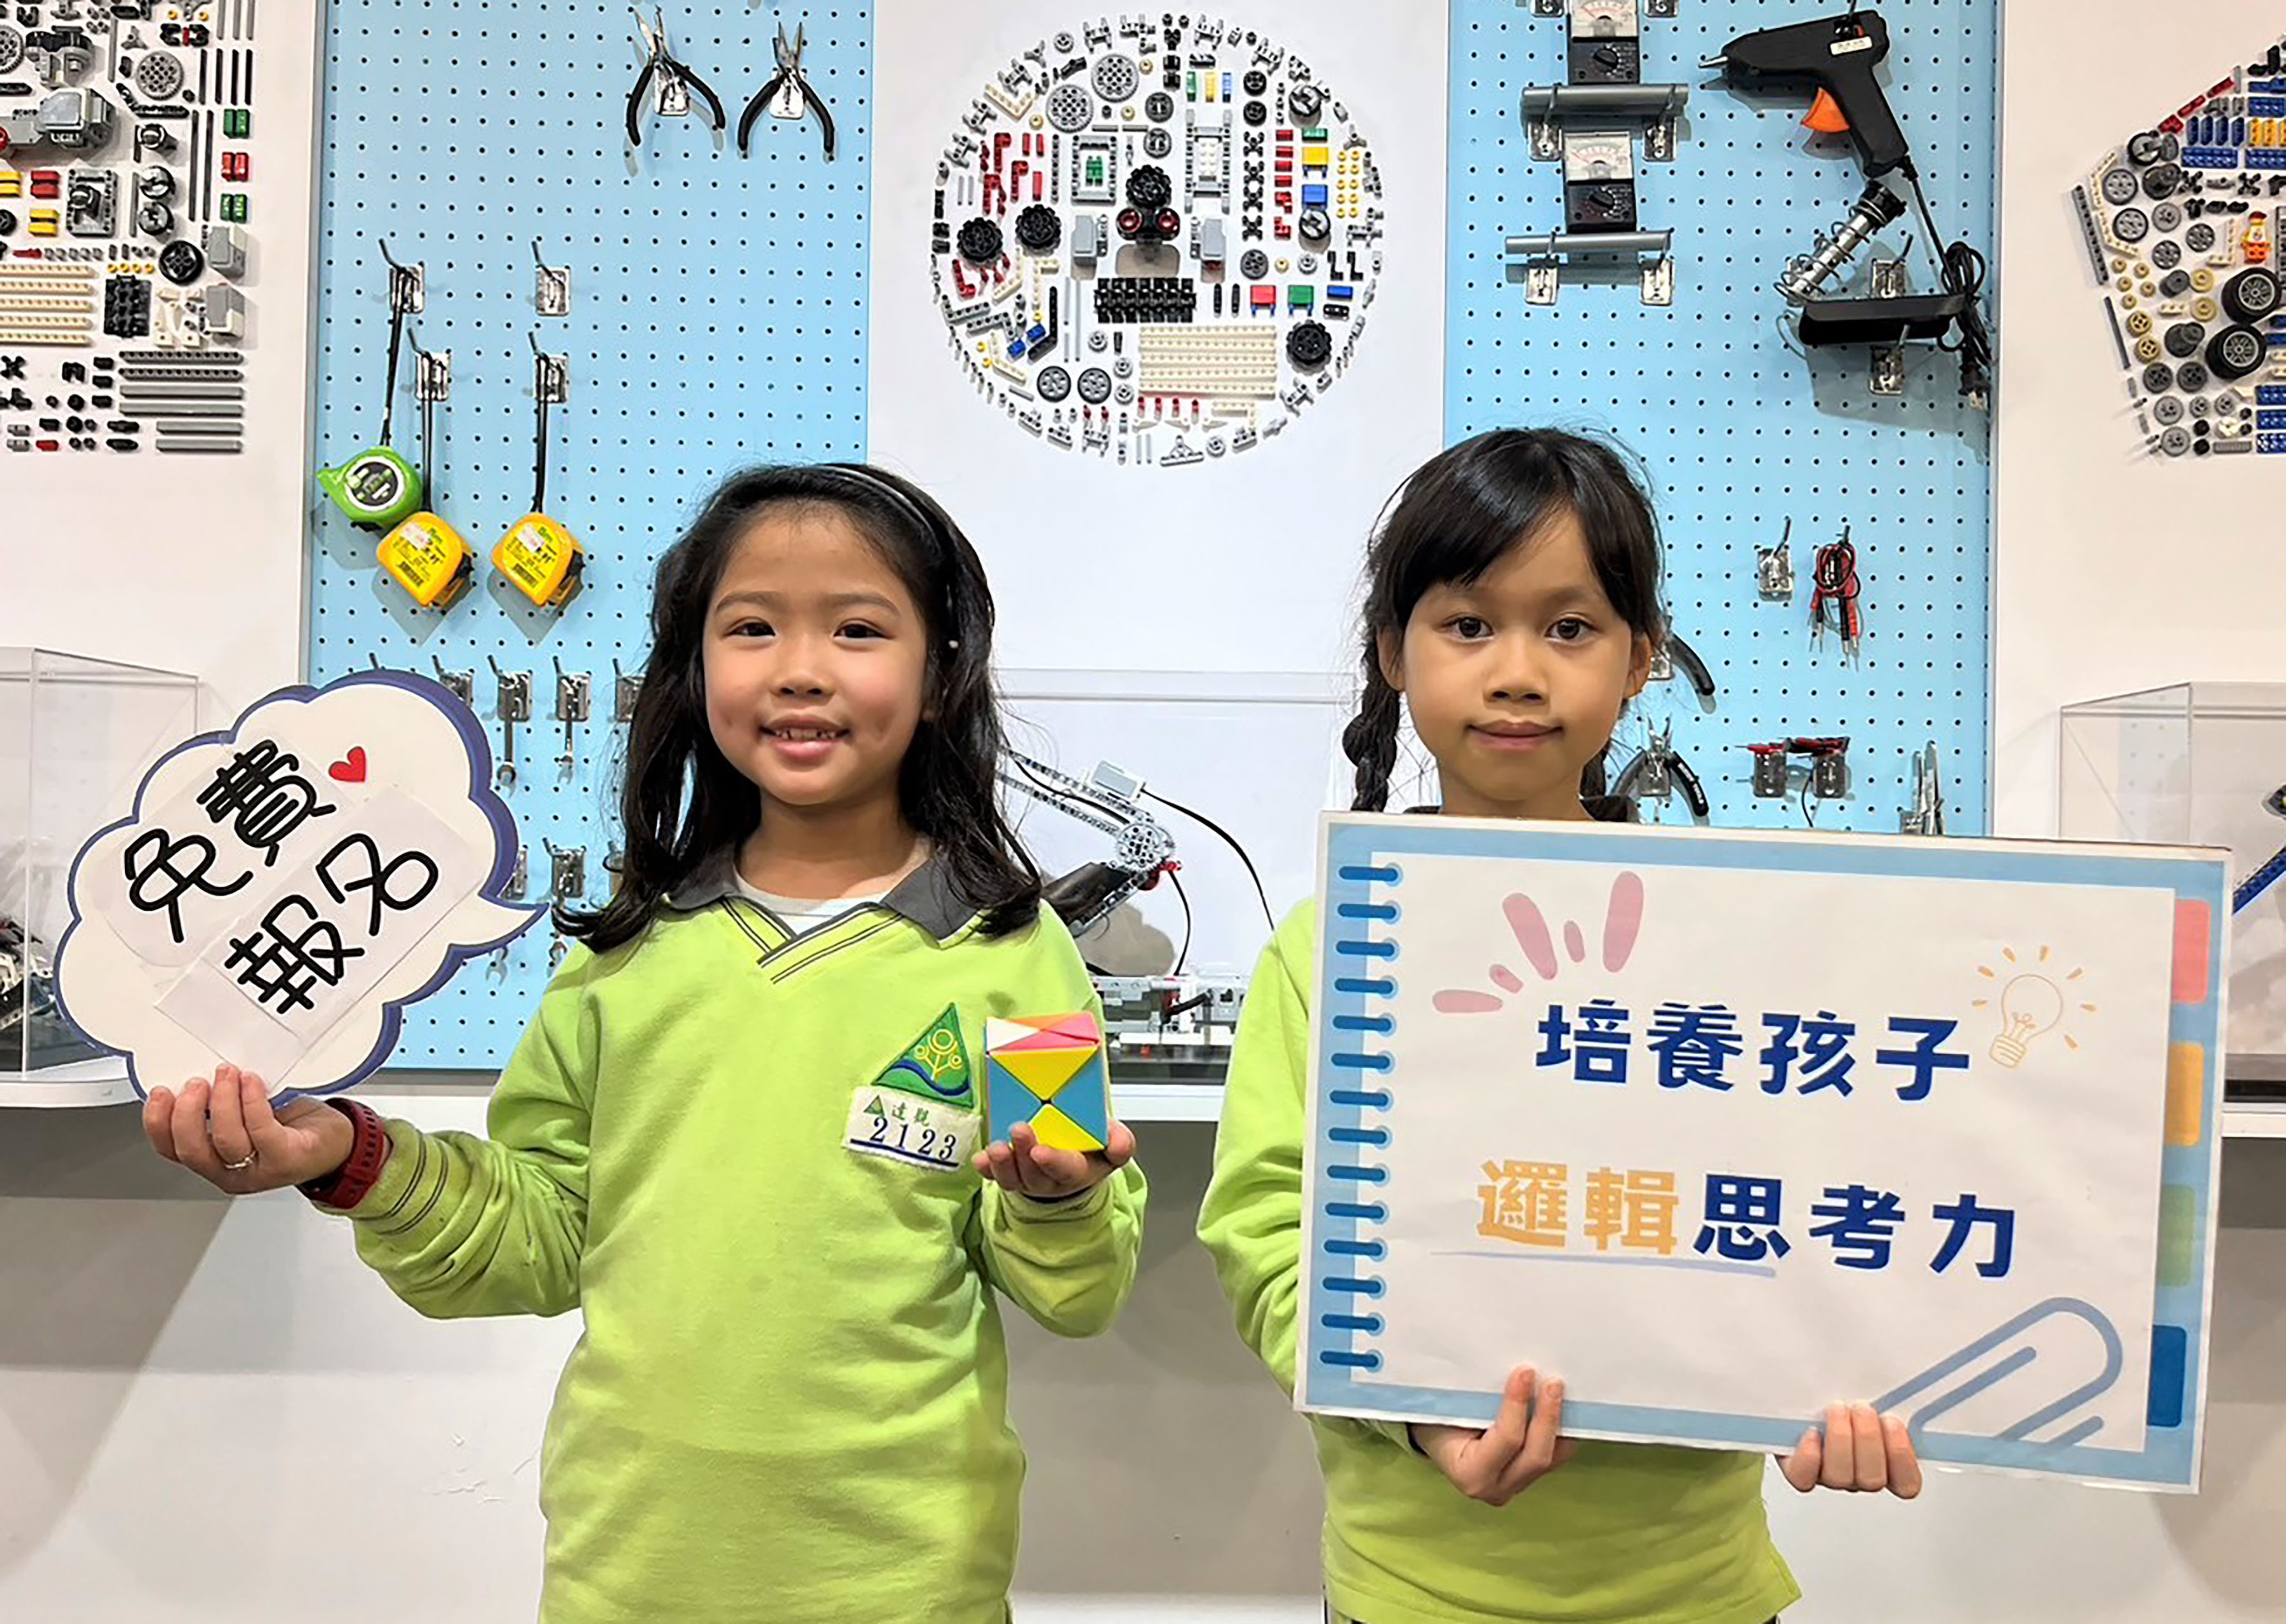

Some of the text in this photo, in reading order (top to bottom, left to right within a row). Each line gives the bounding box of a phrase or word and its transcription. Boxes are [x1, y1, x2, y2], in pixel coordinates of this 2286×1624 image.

[124, 739, 337, 944] 免費
[224, 832, 438, 1015] 報名
[1535, 999, 1969, 1102] 培養孩子
[869, 1117, 956, 1161] 2123
[1477, 1159, 2015, 1277] 邏輯思考力
